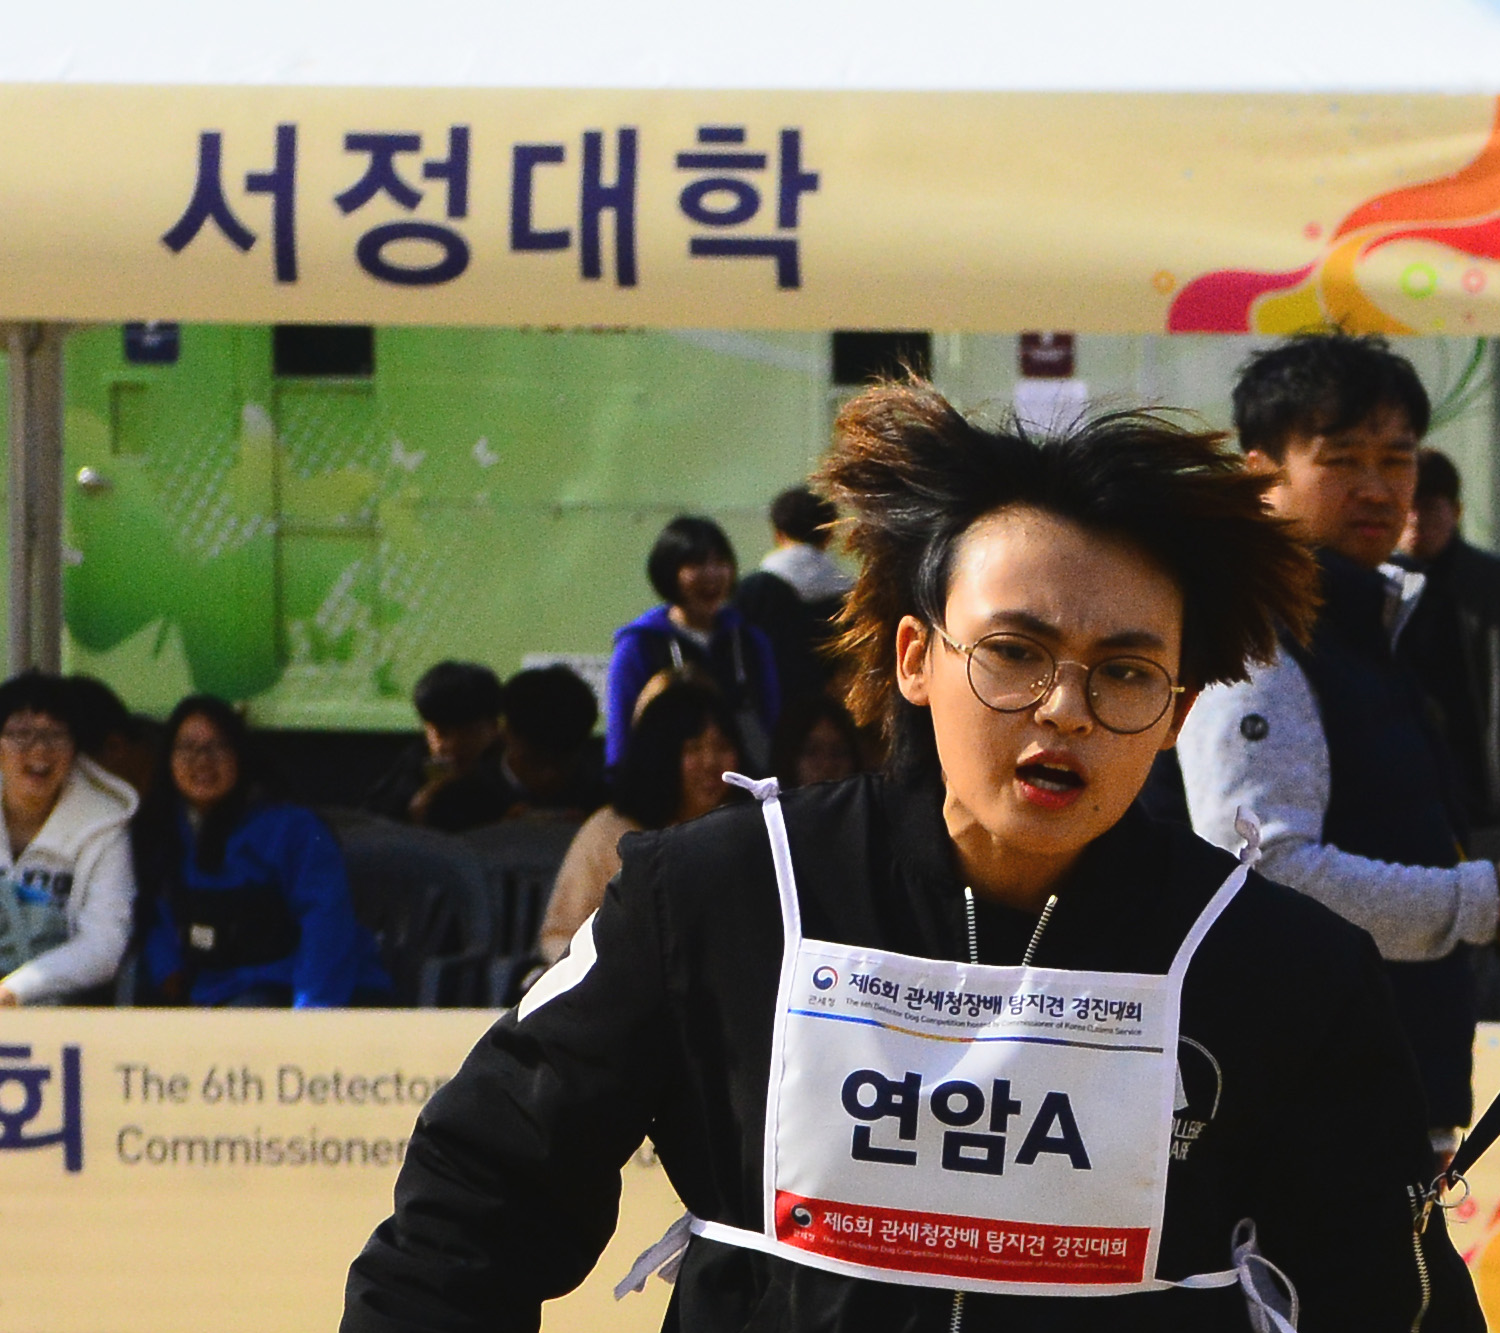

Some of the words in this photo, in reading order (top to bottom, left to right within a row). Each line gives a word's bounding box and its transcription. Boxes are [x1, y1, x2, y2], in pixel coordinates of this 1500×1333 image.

[160, 122, 820, 290] 서정대학
[849, 973, 900, 1004] 제6회
[904, 986, 1003, 1018] 관세청장배
[1008, 993, 1065, 1018] 탐지견
[1071, 997, 1143, 1023] 경진대회
[117, 1065, 190, 1103] The
[202, 1064, 264, 1103] 6th
[840, 1068, 1093, 1177] 연암A
[823, 1211, 873, 1238] 제6회
[879, 1219, 980, 1249] 관세청장배
[986, 1230, 1046, 1257] 탐지견
[1052, 1236, 1128, 1258] 경진대회
